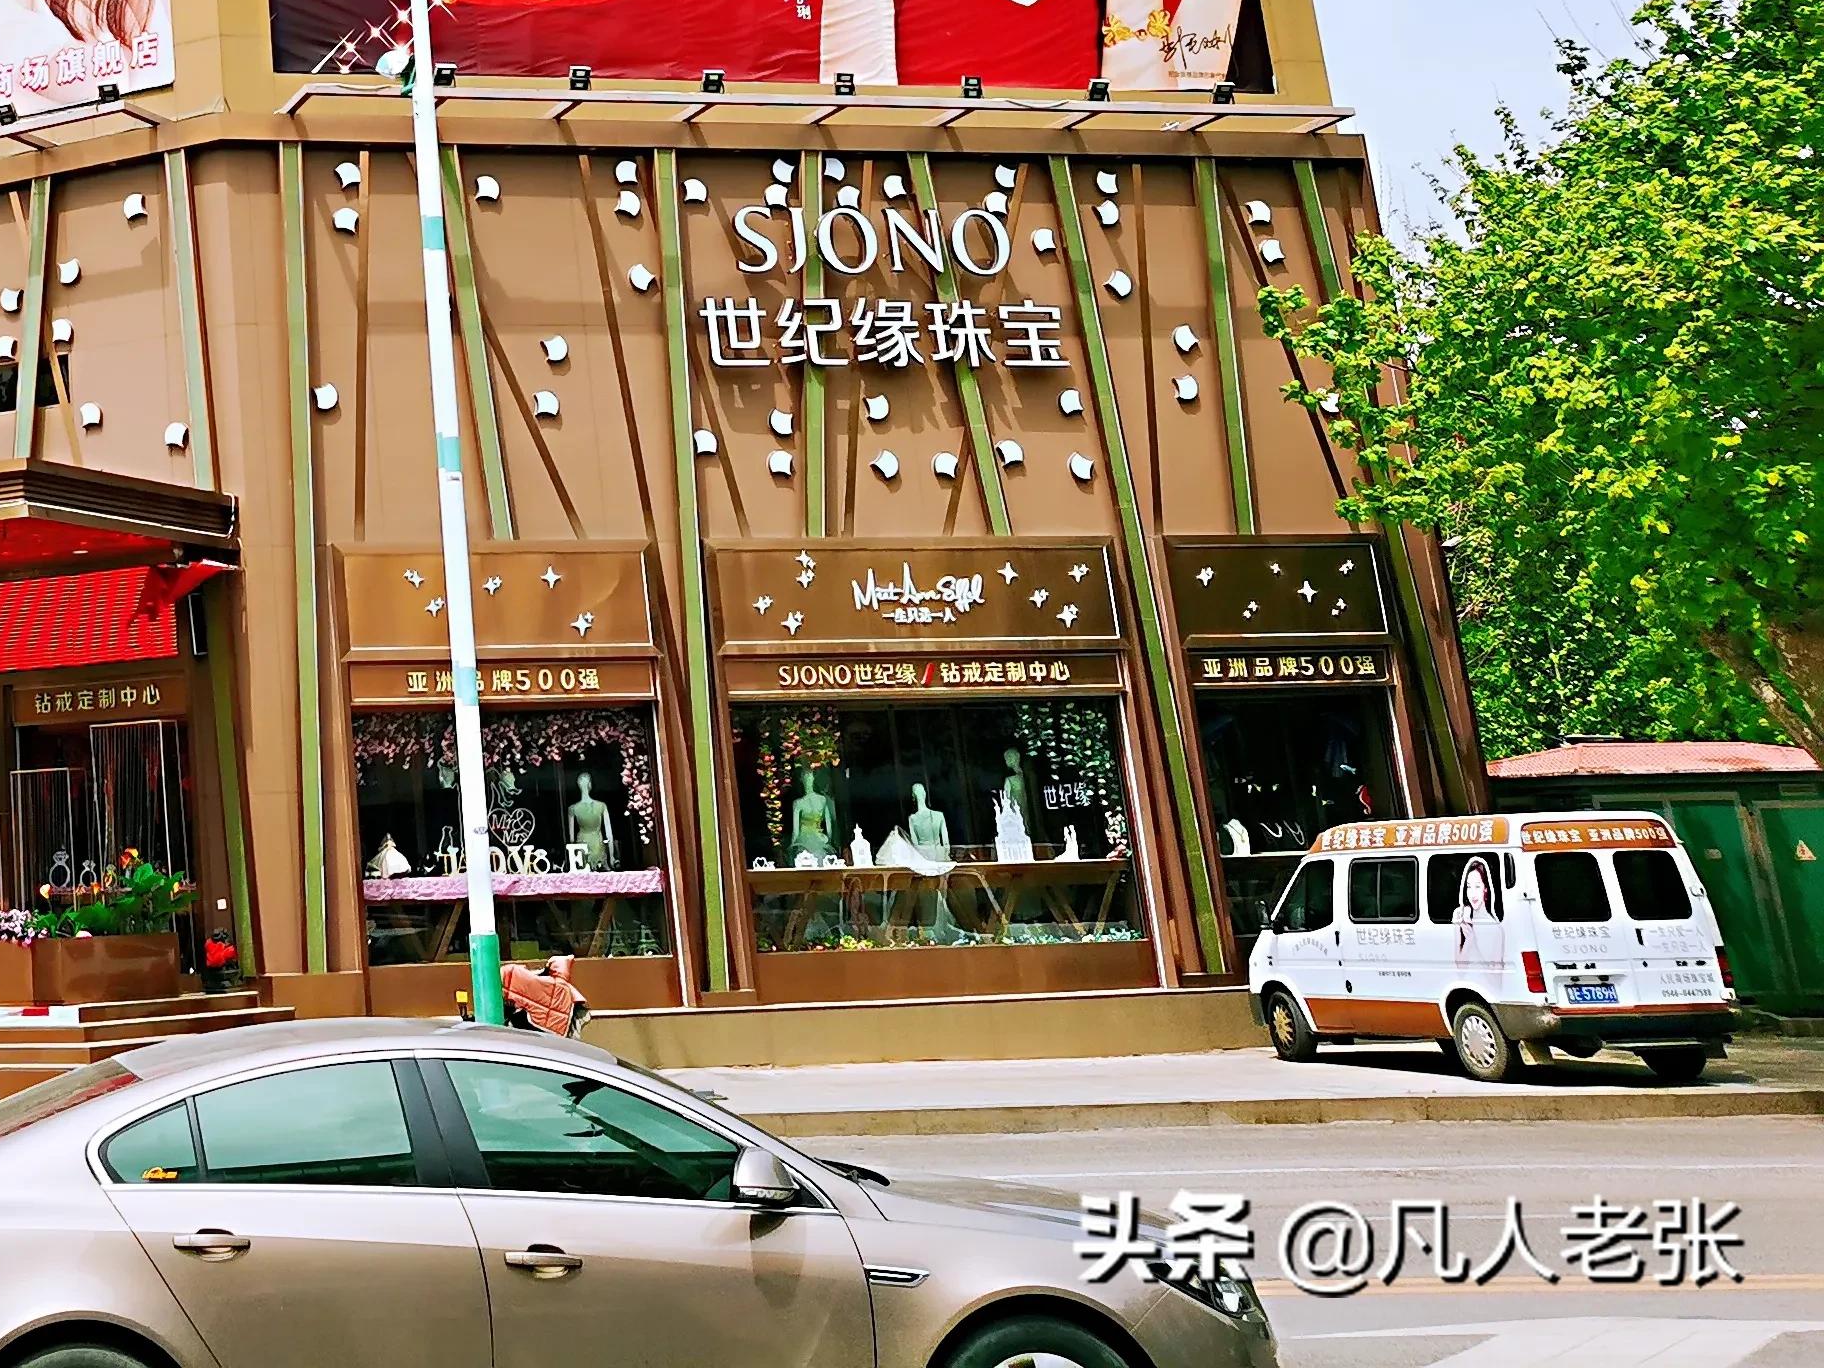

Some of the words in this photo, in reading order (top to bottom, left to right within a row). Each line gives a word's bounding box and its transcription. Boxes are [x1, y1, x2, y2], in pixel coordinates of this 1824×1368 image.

[732, 205, 1012, 277] SJONO
[699, 295, 1072, 369] 世纪缘珠宝
[1200, 655, 1377, 679] 亚洲品牌500强
[34, 684, 161, 714] 钻戒定制中心
[1321, 826, 1387, 851] 世纪缘珠宝
[1394, 820, 1495, 847] 亚洲品牌500强
[1522, 829, 1583, 845] 世纪缘珠宝
[1587, 826, 1669, 843] 亚洲品牌500强
[1356, 928, 1416, 945] 世纪缘珠宝
